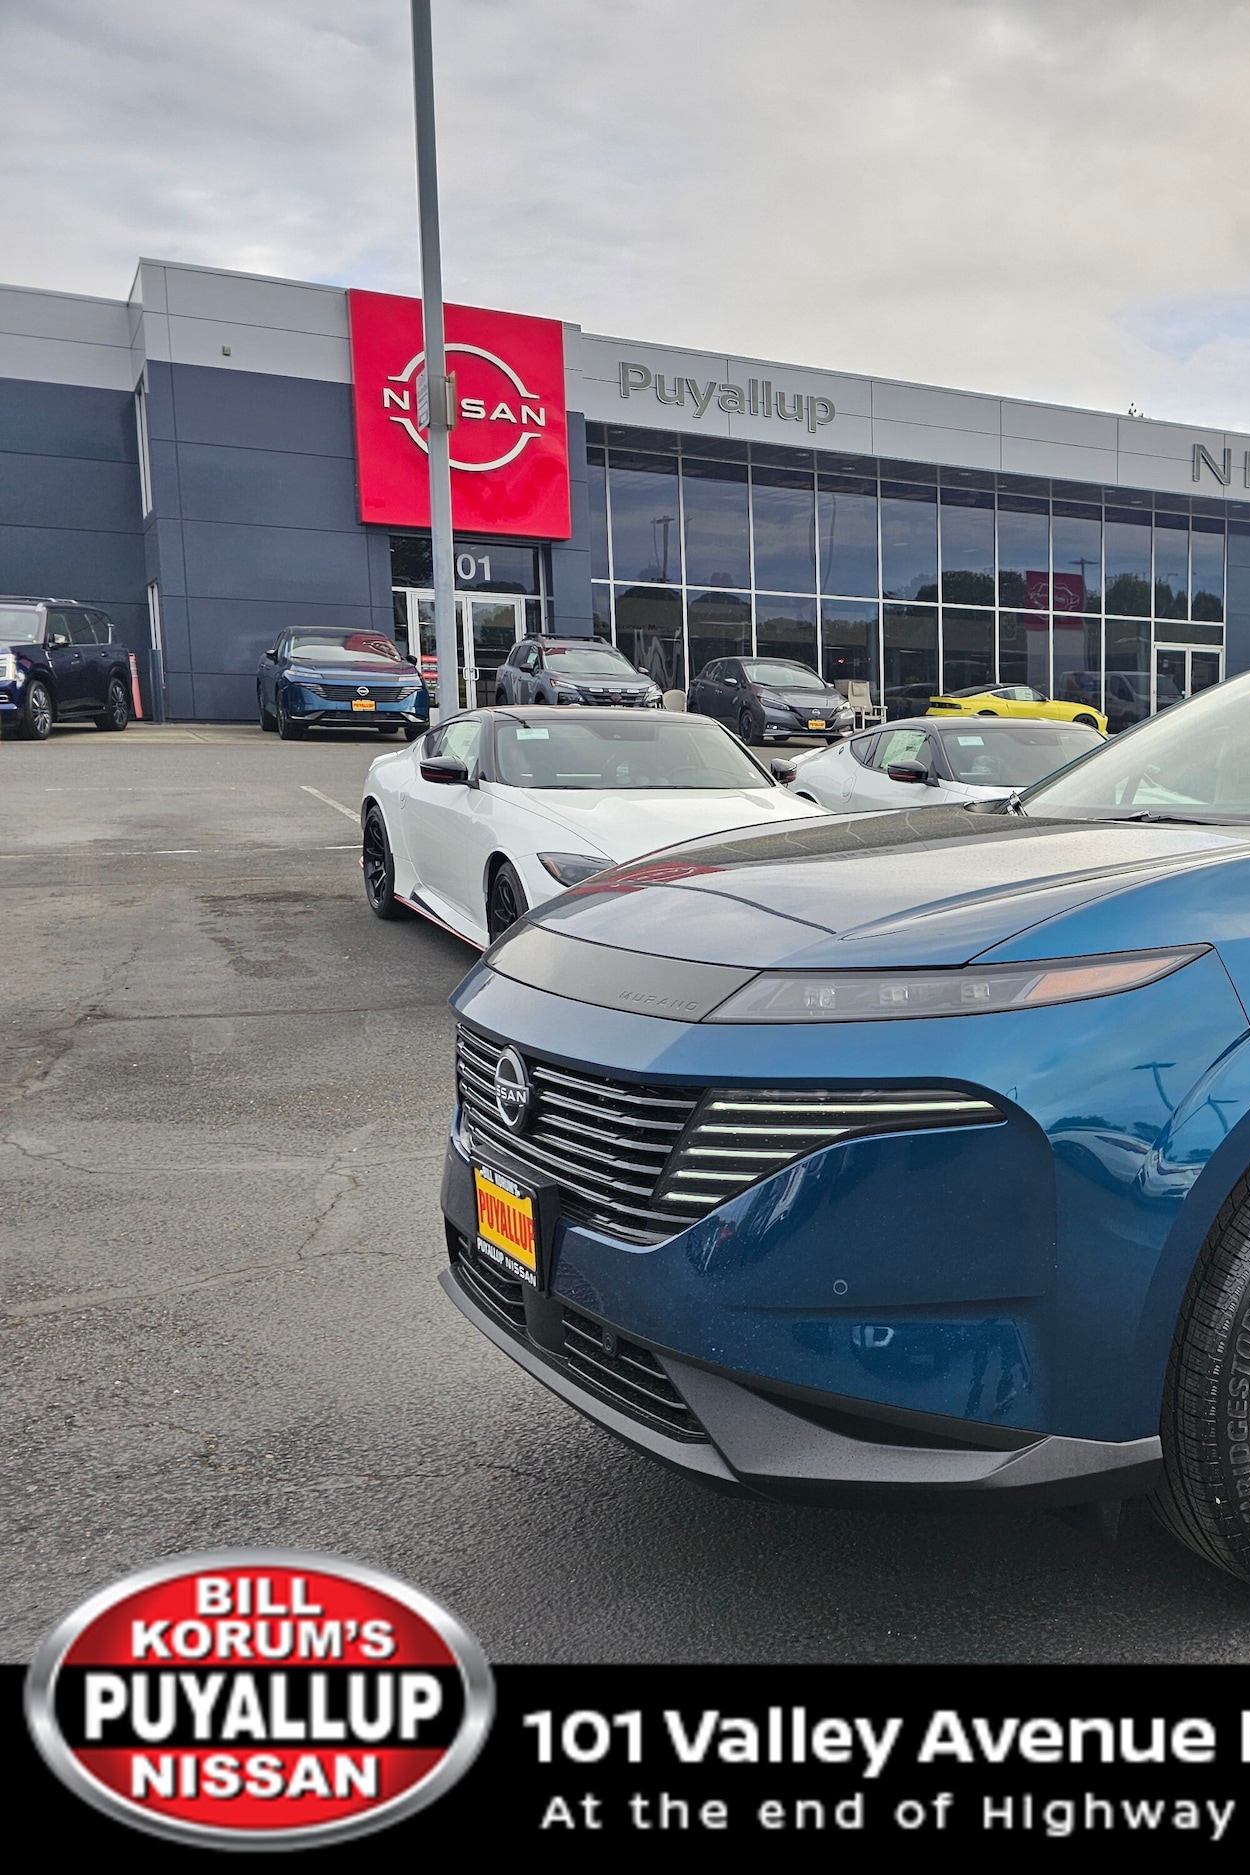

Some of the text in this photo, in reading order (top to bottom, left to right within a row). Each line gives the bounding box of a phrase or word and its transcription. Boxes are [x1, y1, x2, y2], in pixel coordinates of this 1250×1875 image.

[382, 387, 546, 427] NSAN
[618, 361, 837, 433] Puyallup
[455, 553, 491, 581] 01
[618, 990, 699, 1012] MURANO
[478, 1187, 536, 1255] PUYALLUP
[476, 1236, 537, 1288] PUYALLUP NISSAN
